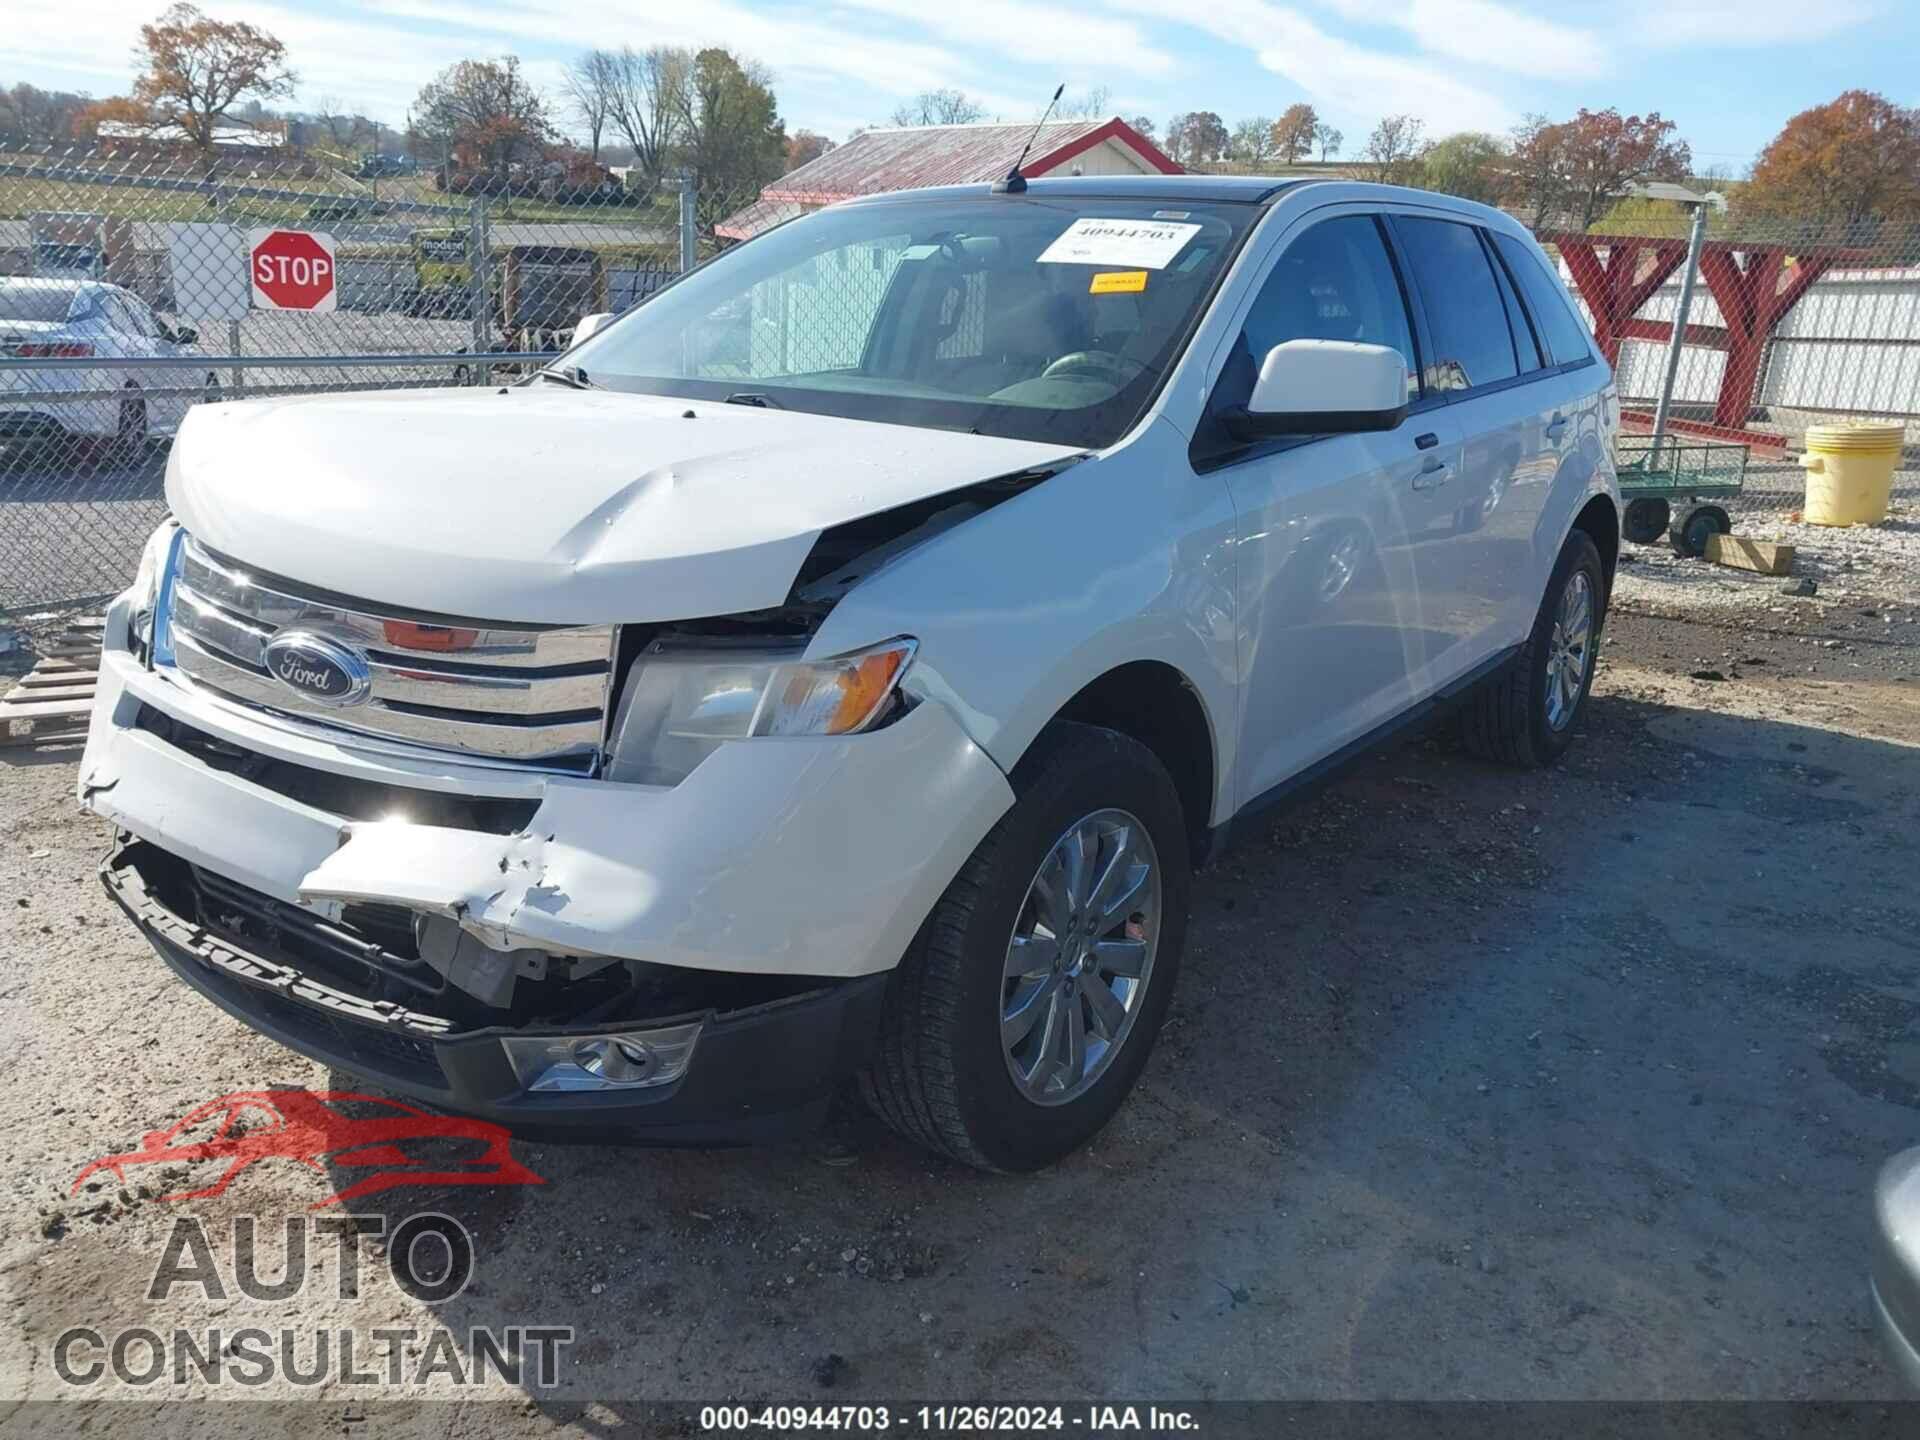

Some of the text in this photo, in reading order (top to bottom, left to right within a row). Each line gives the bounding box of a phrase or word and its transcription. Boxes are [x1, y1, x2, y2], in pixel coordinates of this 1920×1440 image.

[1077, 226, 1176, 241] 40944703
[257, 254, 329, 286] STOP
[280, 650, 330, 690] Ford
